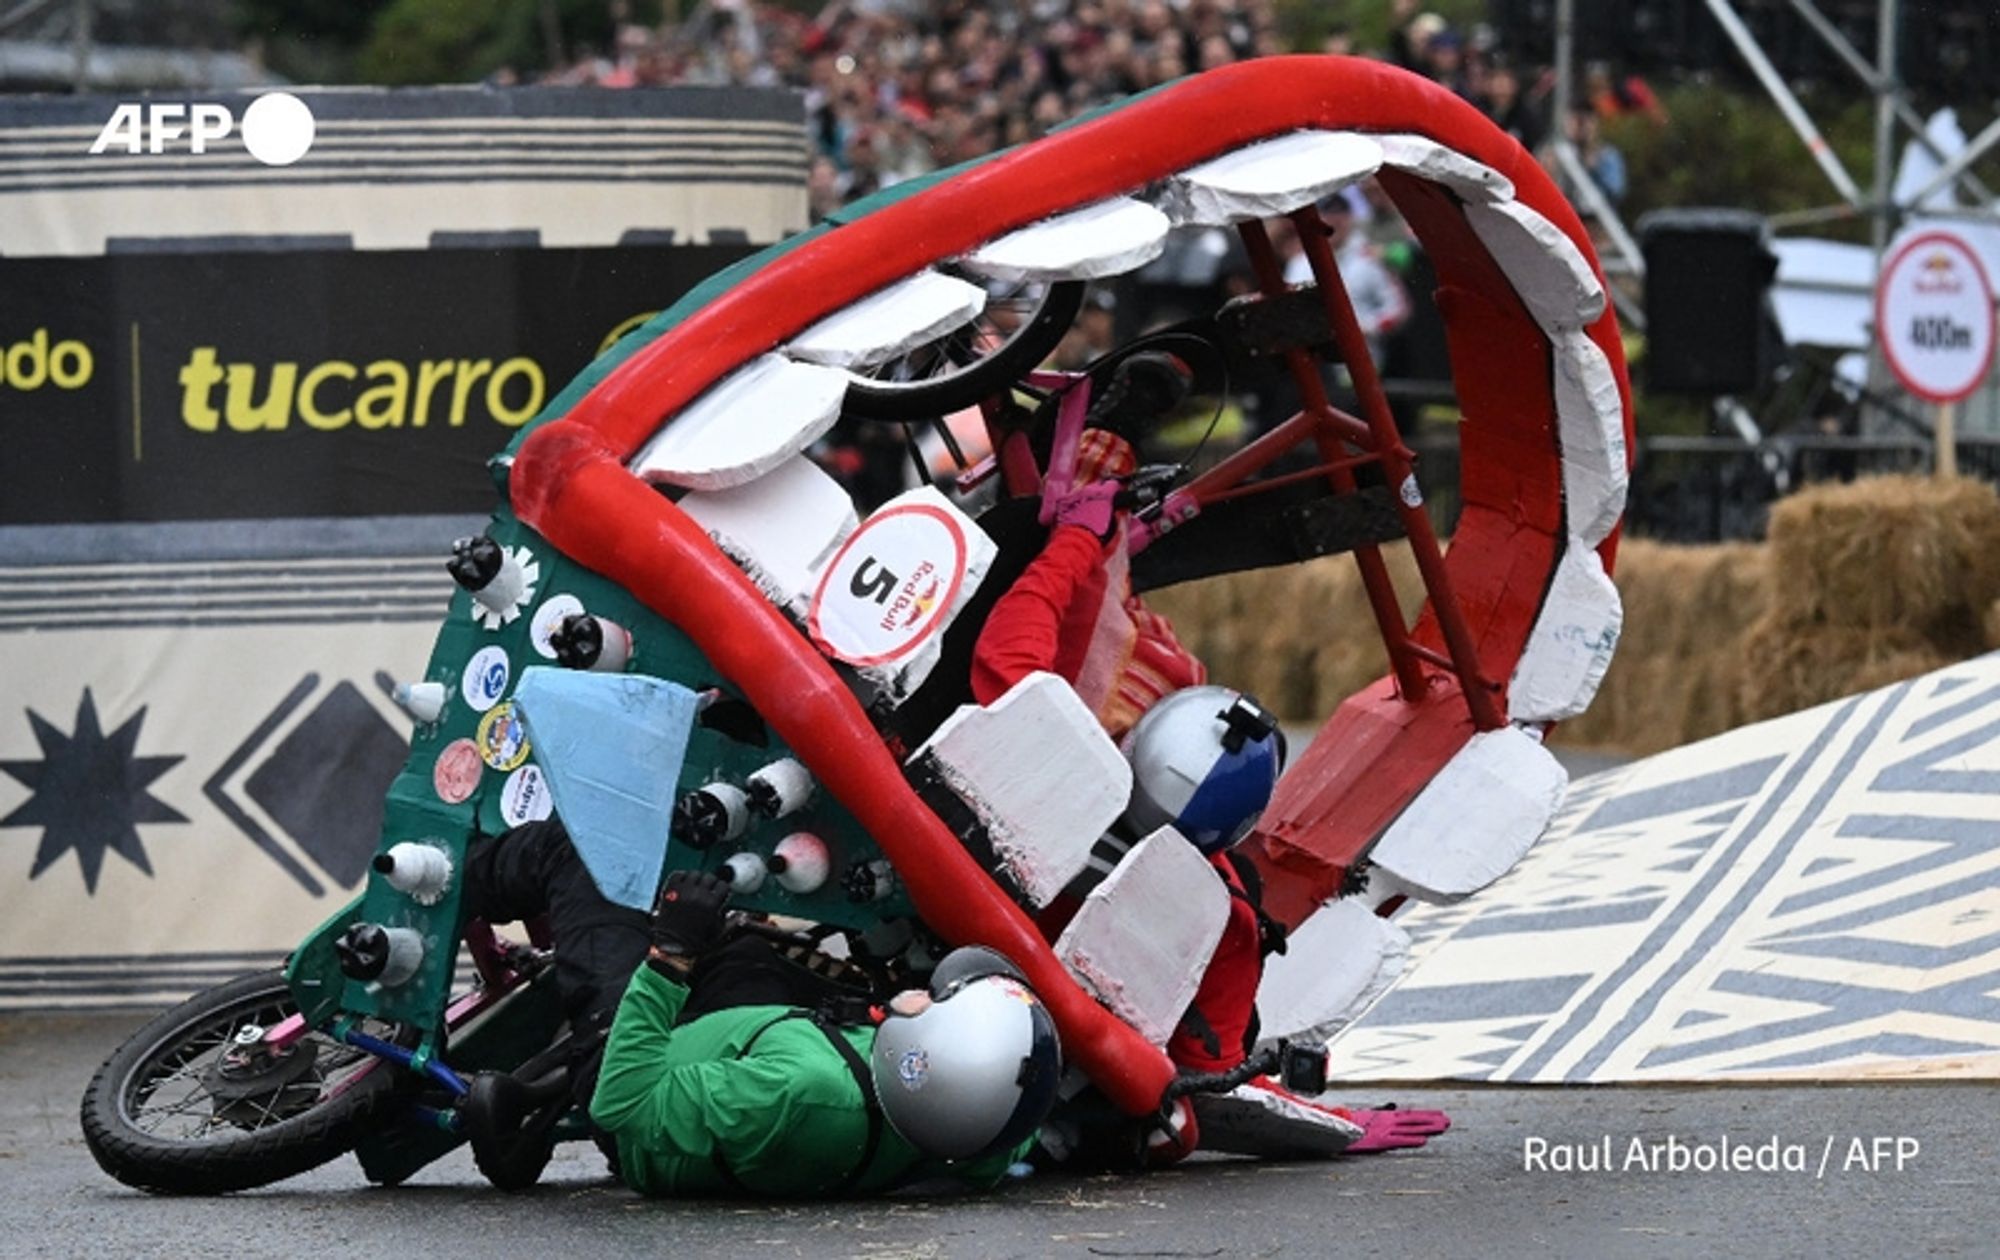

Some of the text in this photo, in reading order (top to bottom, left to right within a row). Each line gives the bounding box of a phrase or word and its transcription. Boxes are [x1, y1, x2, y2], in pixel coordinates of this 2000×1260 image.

[0, 328, 94, 391] do
[179, 347, 545, 432] tucarro
[850, 555, 899, 606] 5
[880, 560, 934, 632] Red Bull
